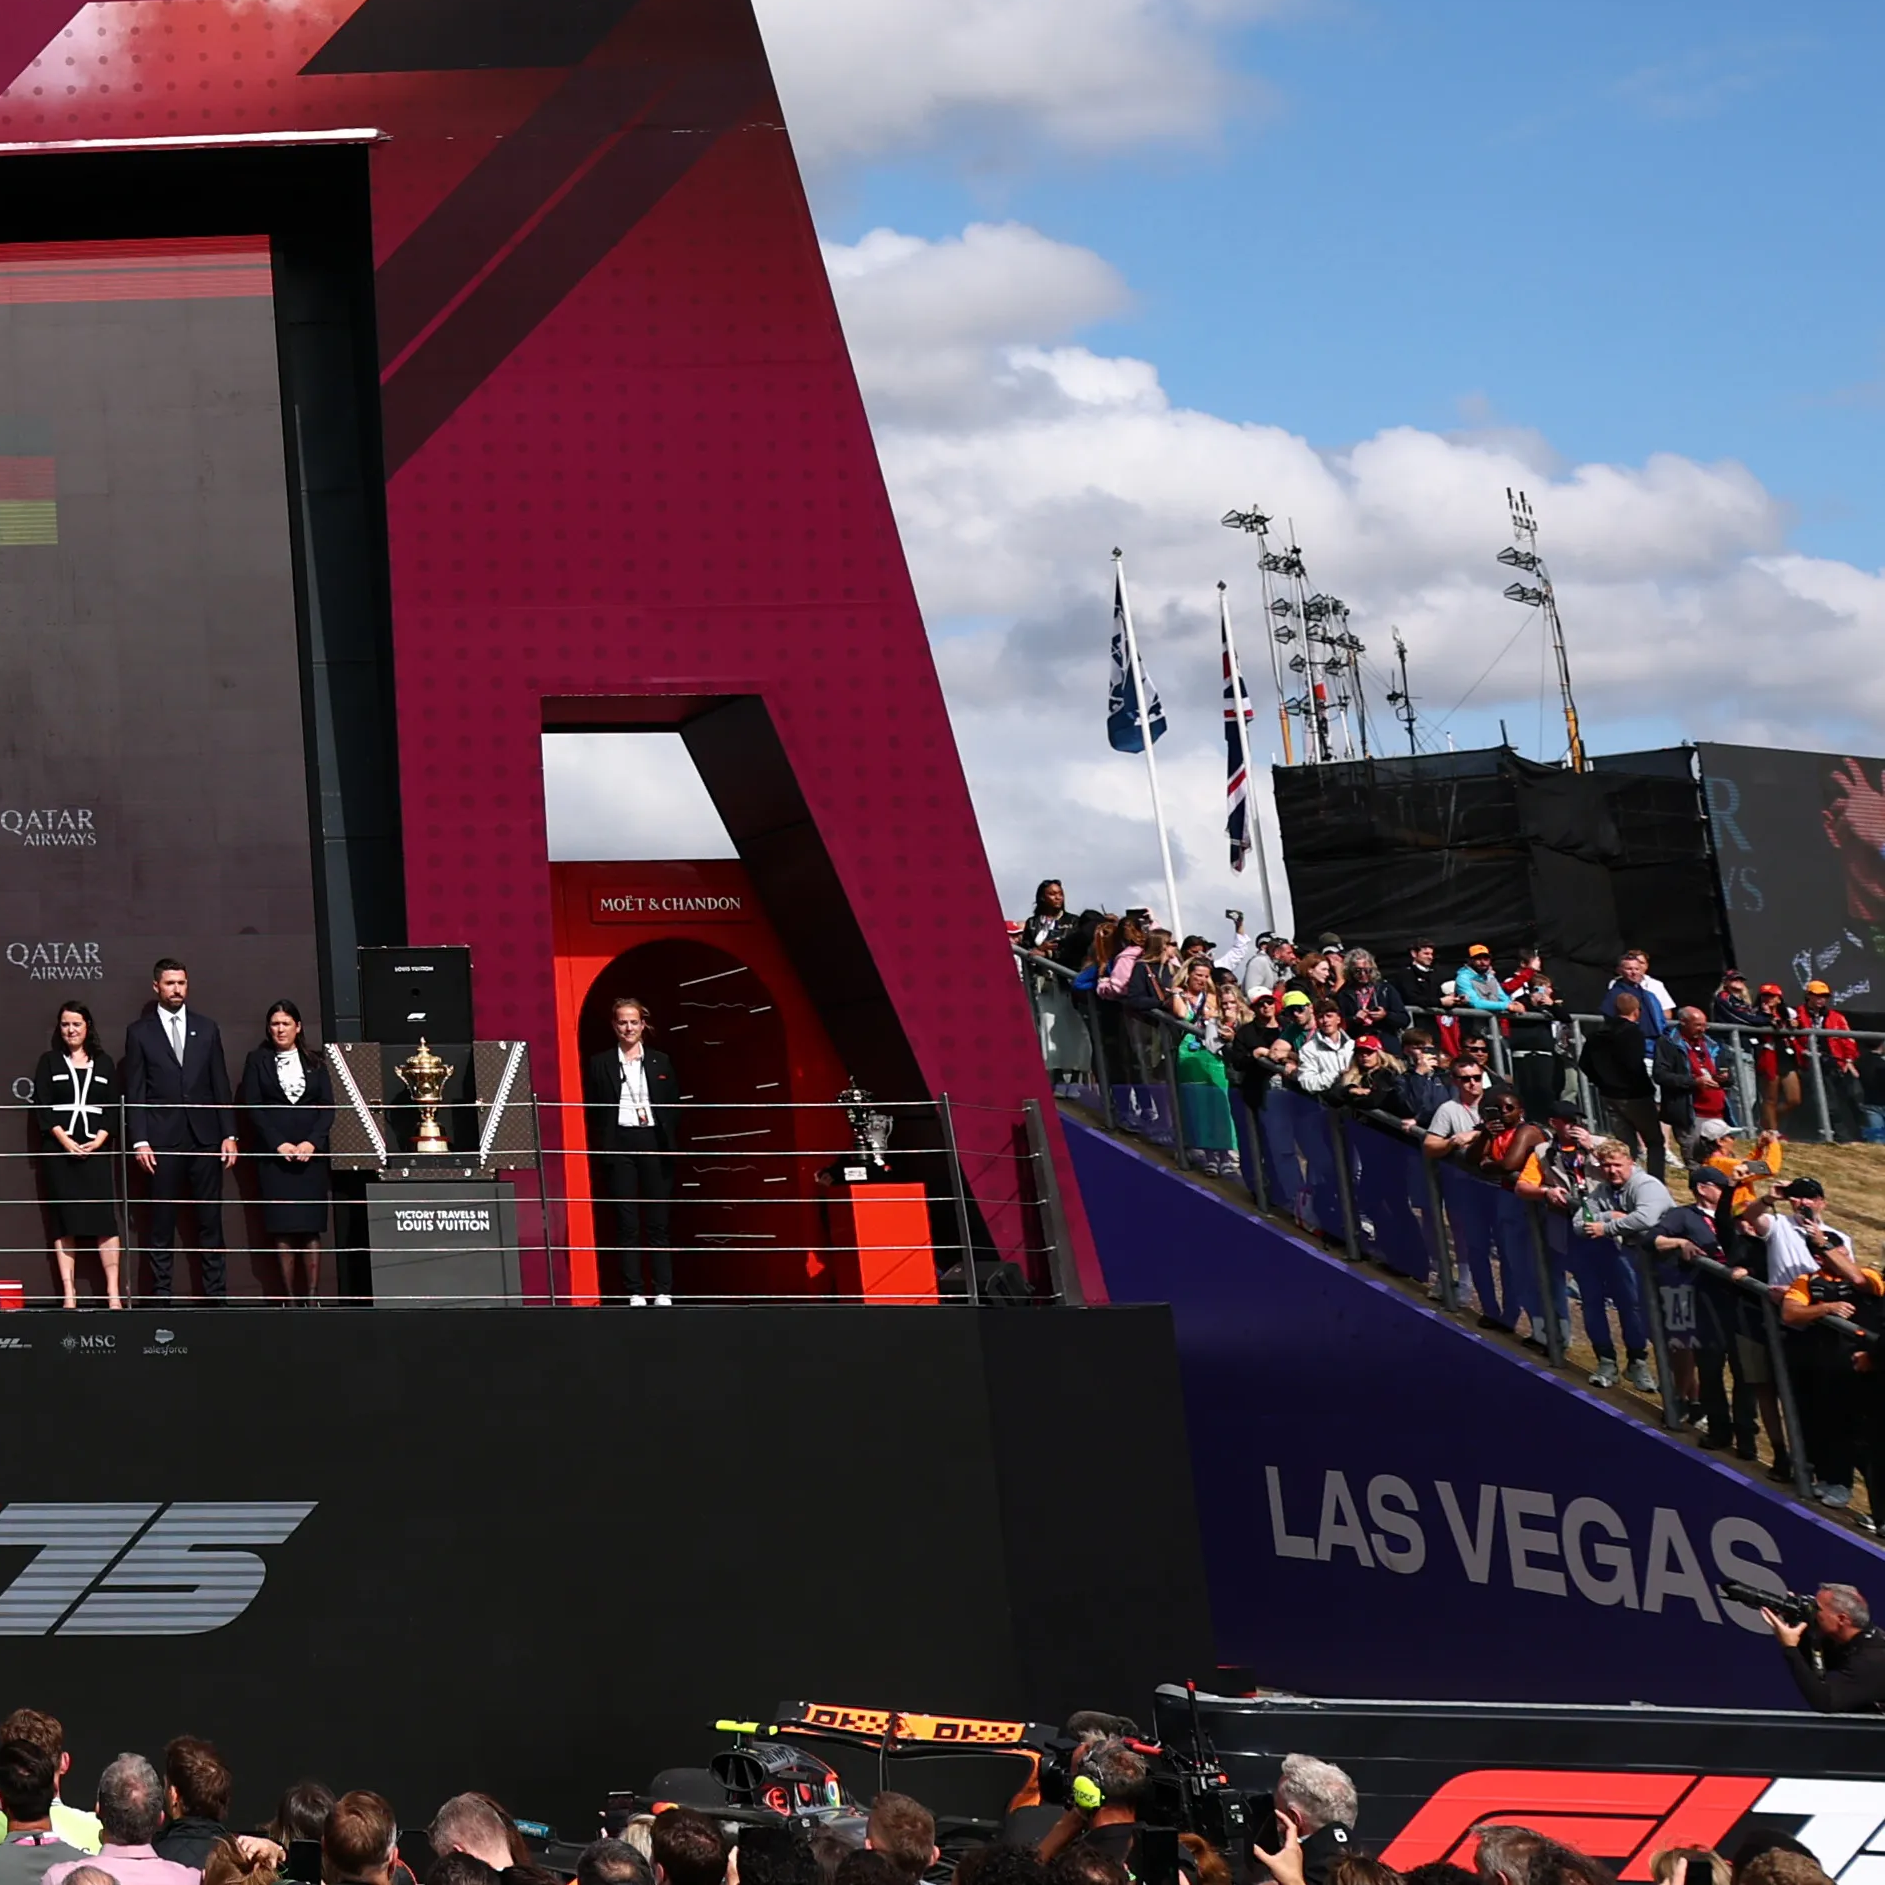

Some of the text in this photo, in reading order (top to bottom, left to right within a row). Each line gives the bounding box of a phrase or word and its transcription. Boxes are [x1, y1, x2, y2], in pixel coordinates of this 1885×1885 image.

[0, 809, 95, 834] QATAR
[23, 832, 97, 847] AIRWAYS
[600, 895, 741, 911] MOËT & CHANDON
[6, 942, 102, 967] QATAR
[30, 965, 104, 981] AIRWAYS
[395, 1210, 489, 1219] VICTORY TRAVELS IN
[397, 1219, 490, 1231] LOUIS VUITTON
[80, 1335, 116, 1347] MSC
[143, 1344, 188, 1356] salesforce
[1265, 1465, 1790, 1636] LAS VEGAS
